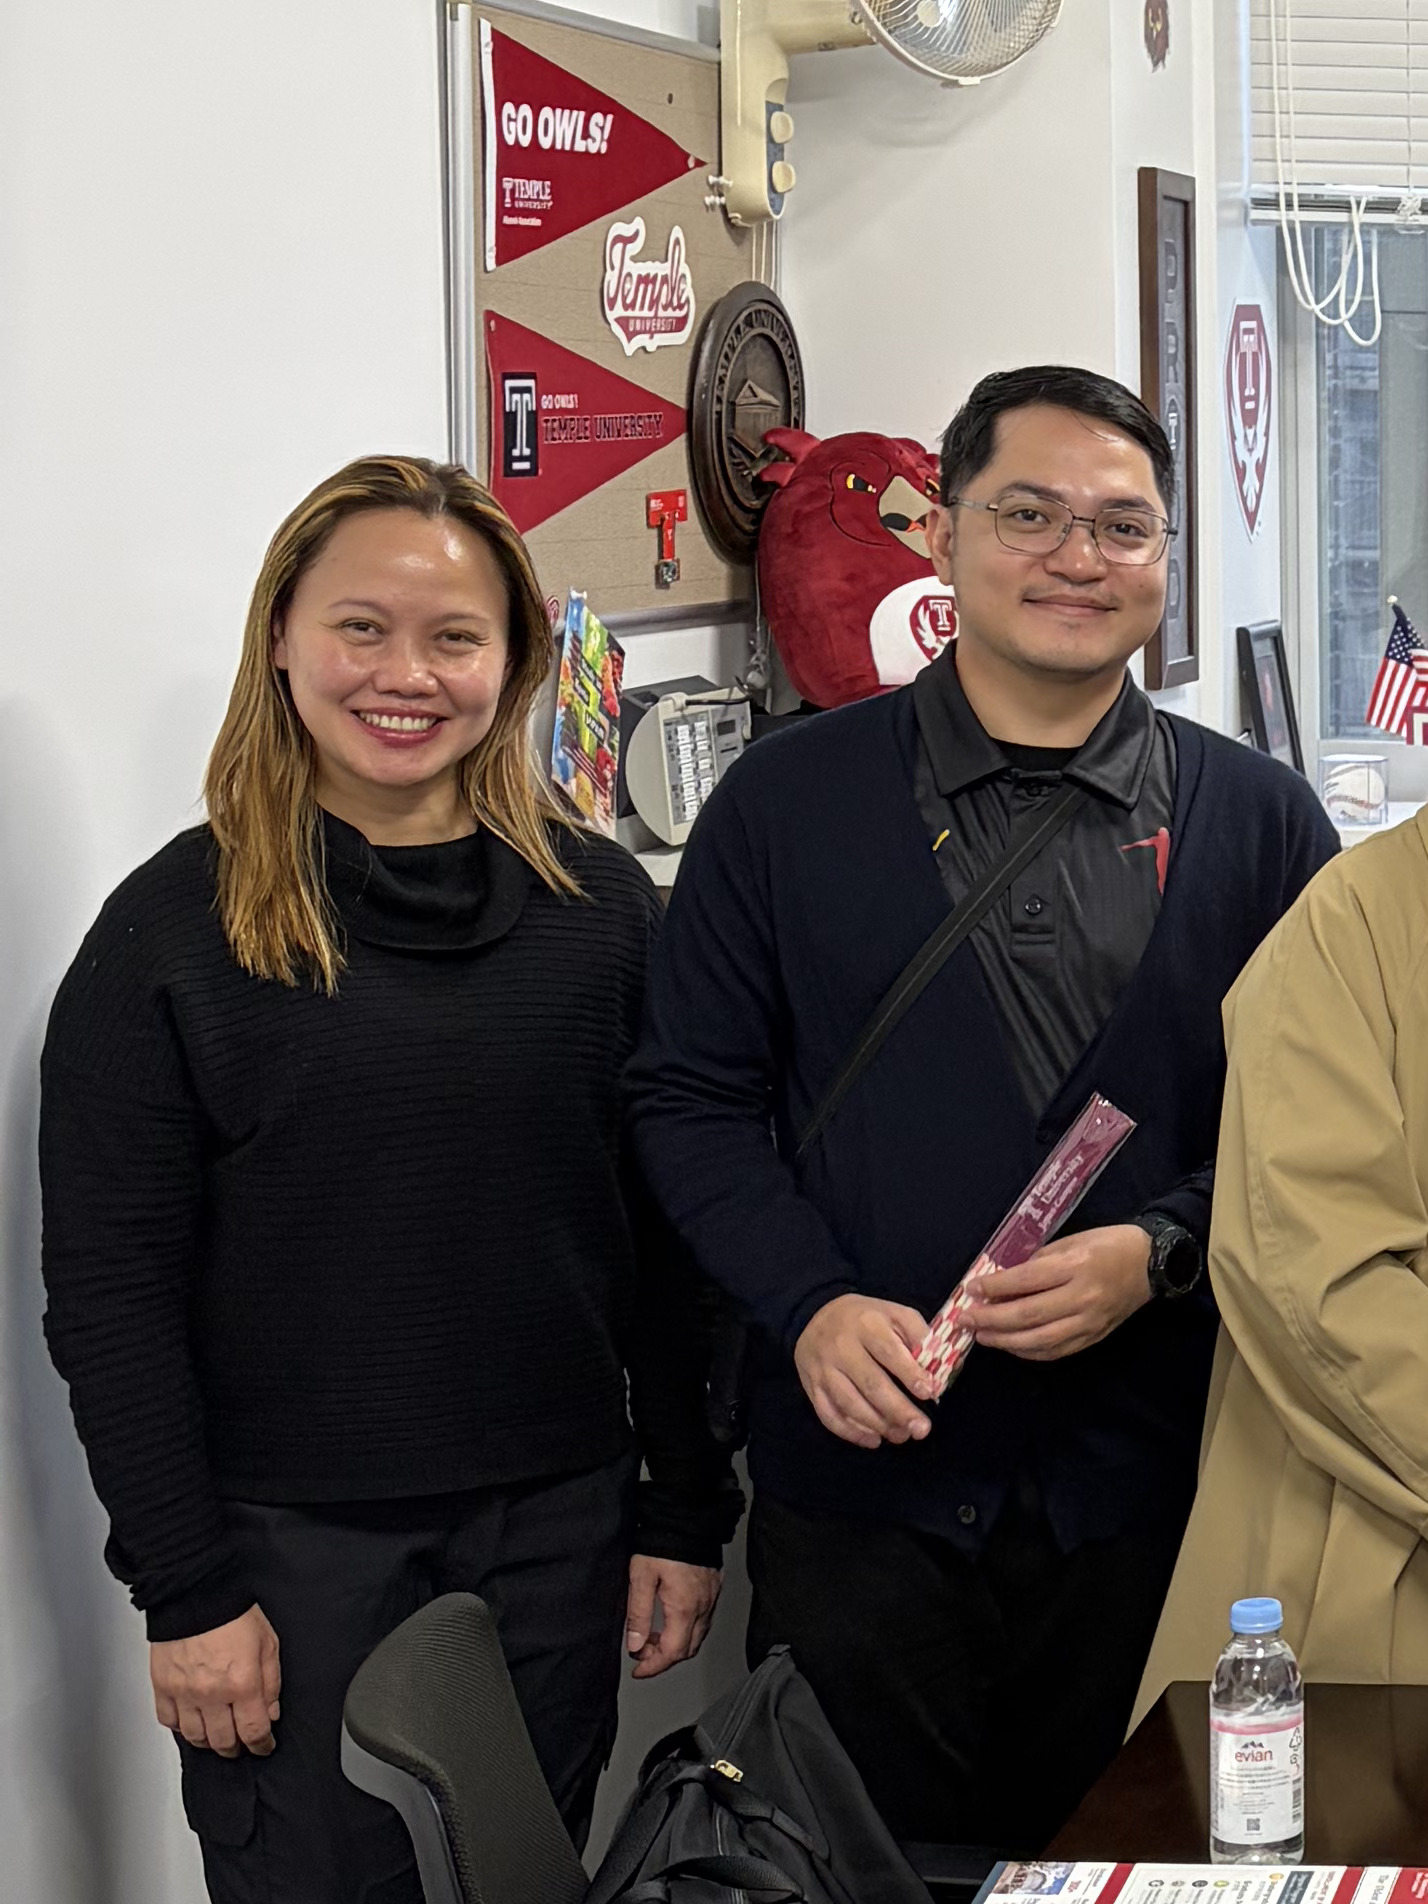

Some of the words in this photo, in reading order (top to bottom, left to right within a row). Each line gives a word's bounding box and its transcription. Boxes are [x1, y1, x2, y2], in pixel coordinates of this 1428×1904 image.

[501, 101, 533, 147] GO
[537, 105, 614, 154] OWLS!
[514, 179, 552, 200] TEMPLE
[606, 228, 690, 328] Temple
[629, 318, 677, 332] UNIVERSITY
[504, 379, 536, 470] T
[543, 415, 591, 443] TEMPLE
[593, 412, 663, 441] UNIVERSITY
[929, 599, 952, 631] T
[1235, 1749, 1273, 1762] evian
